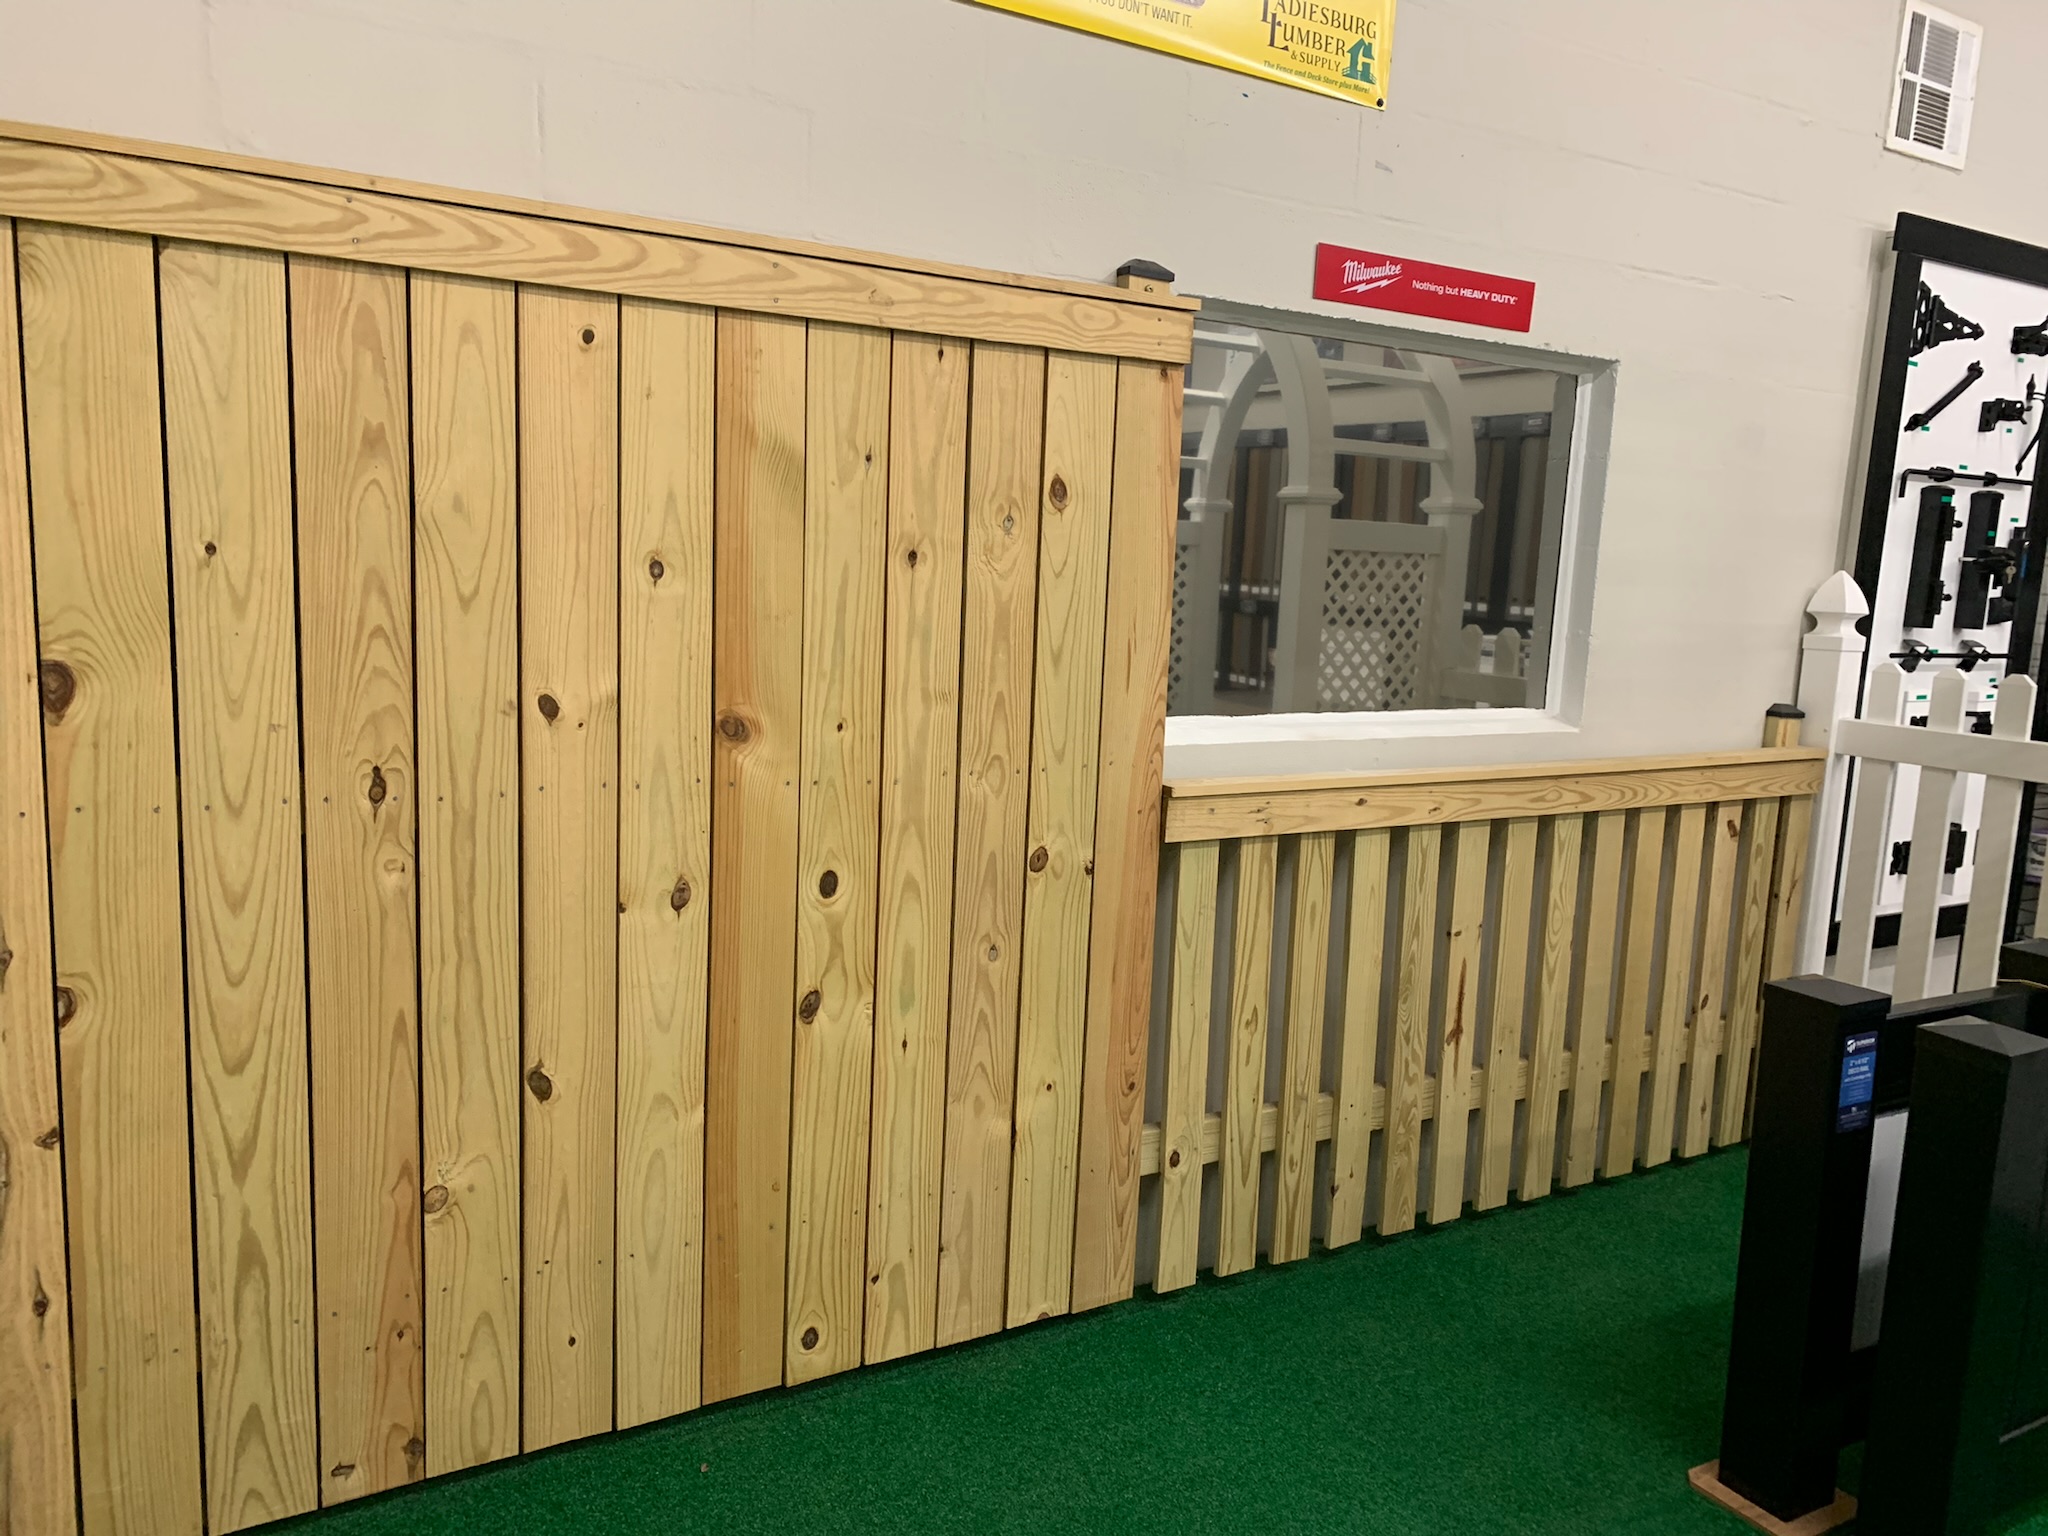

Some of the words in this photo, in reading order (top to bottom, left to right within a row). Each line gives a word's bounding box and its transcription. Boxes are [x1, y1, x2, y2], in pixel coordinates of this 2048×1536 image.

[1118, 0, 1150, 16] DON'T
[1152, 6, 1180, 25] WANT
[1182, 14, 1193, 28] IT.
[1261, 0, 1377, 40] LADIESBURG
[1267, 12, 1346, 58] LUMBER
[1290, 50, 1298, 61] &
[1299, 51, 1341, 72] SUPPLY
[1263, 60, 1275, 69] The
[1276, 63, 1294, 75] Fence
[1294, 69, 1306, 78] and
[1307, 71, 1322, 82] Deck
[1323, 75, 1339, 86] Store
[1338, 81, 1352, 91] plus
[1353, 84, 1371, 95] More!
[1340, 258, 1403, 285] Milwaukee
[1412, 279, 1444, 296] Nothing
[1445, 285, 1459, 296] but
[1460, 287, 1490, 301] HEAVY
